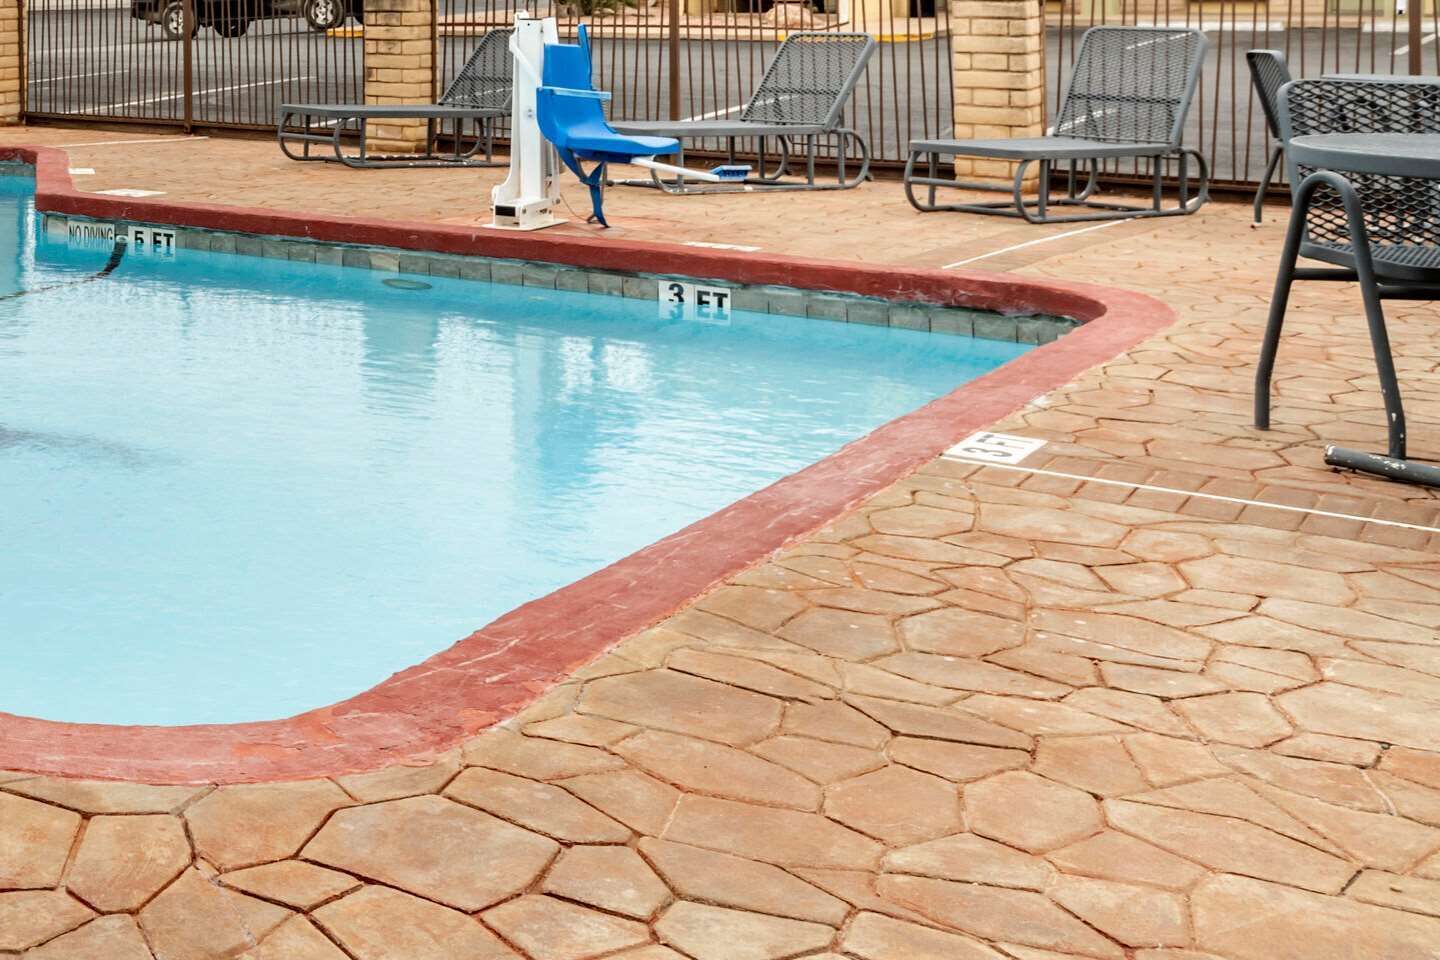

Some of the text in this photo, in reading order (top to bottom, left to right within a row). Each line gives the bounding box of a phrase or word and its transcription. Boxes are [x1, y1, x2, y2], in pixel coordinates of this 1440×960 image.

[68, 224, 113, 242] NO DIVING
[134, 230, 174, 247] 5 FT
[668, 283, 729, 308] 3 FT
